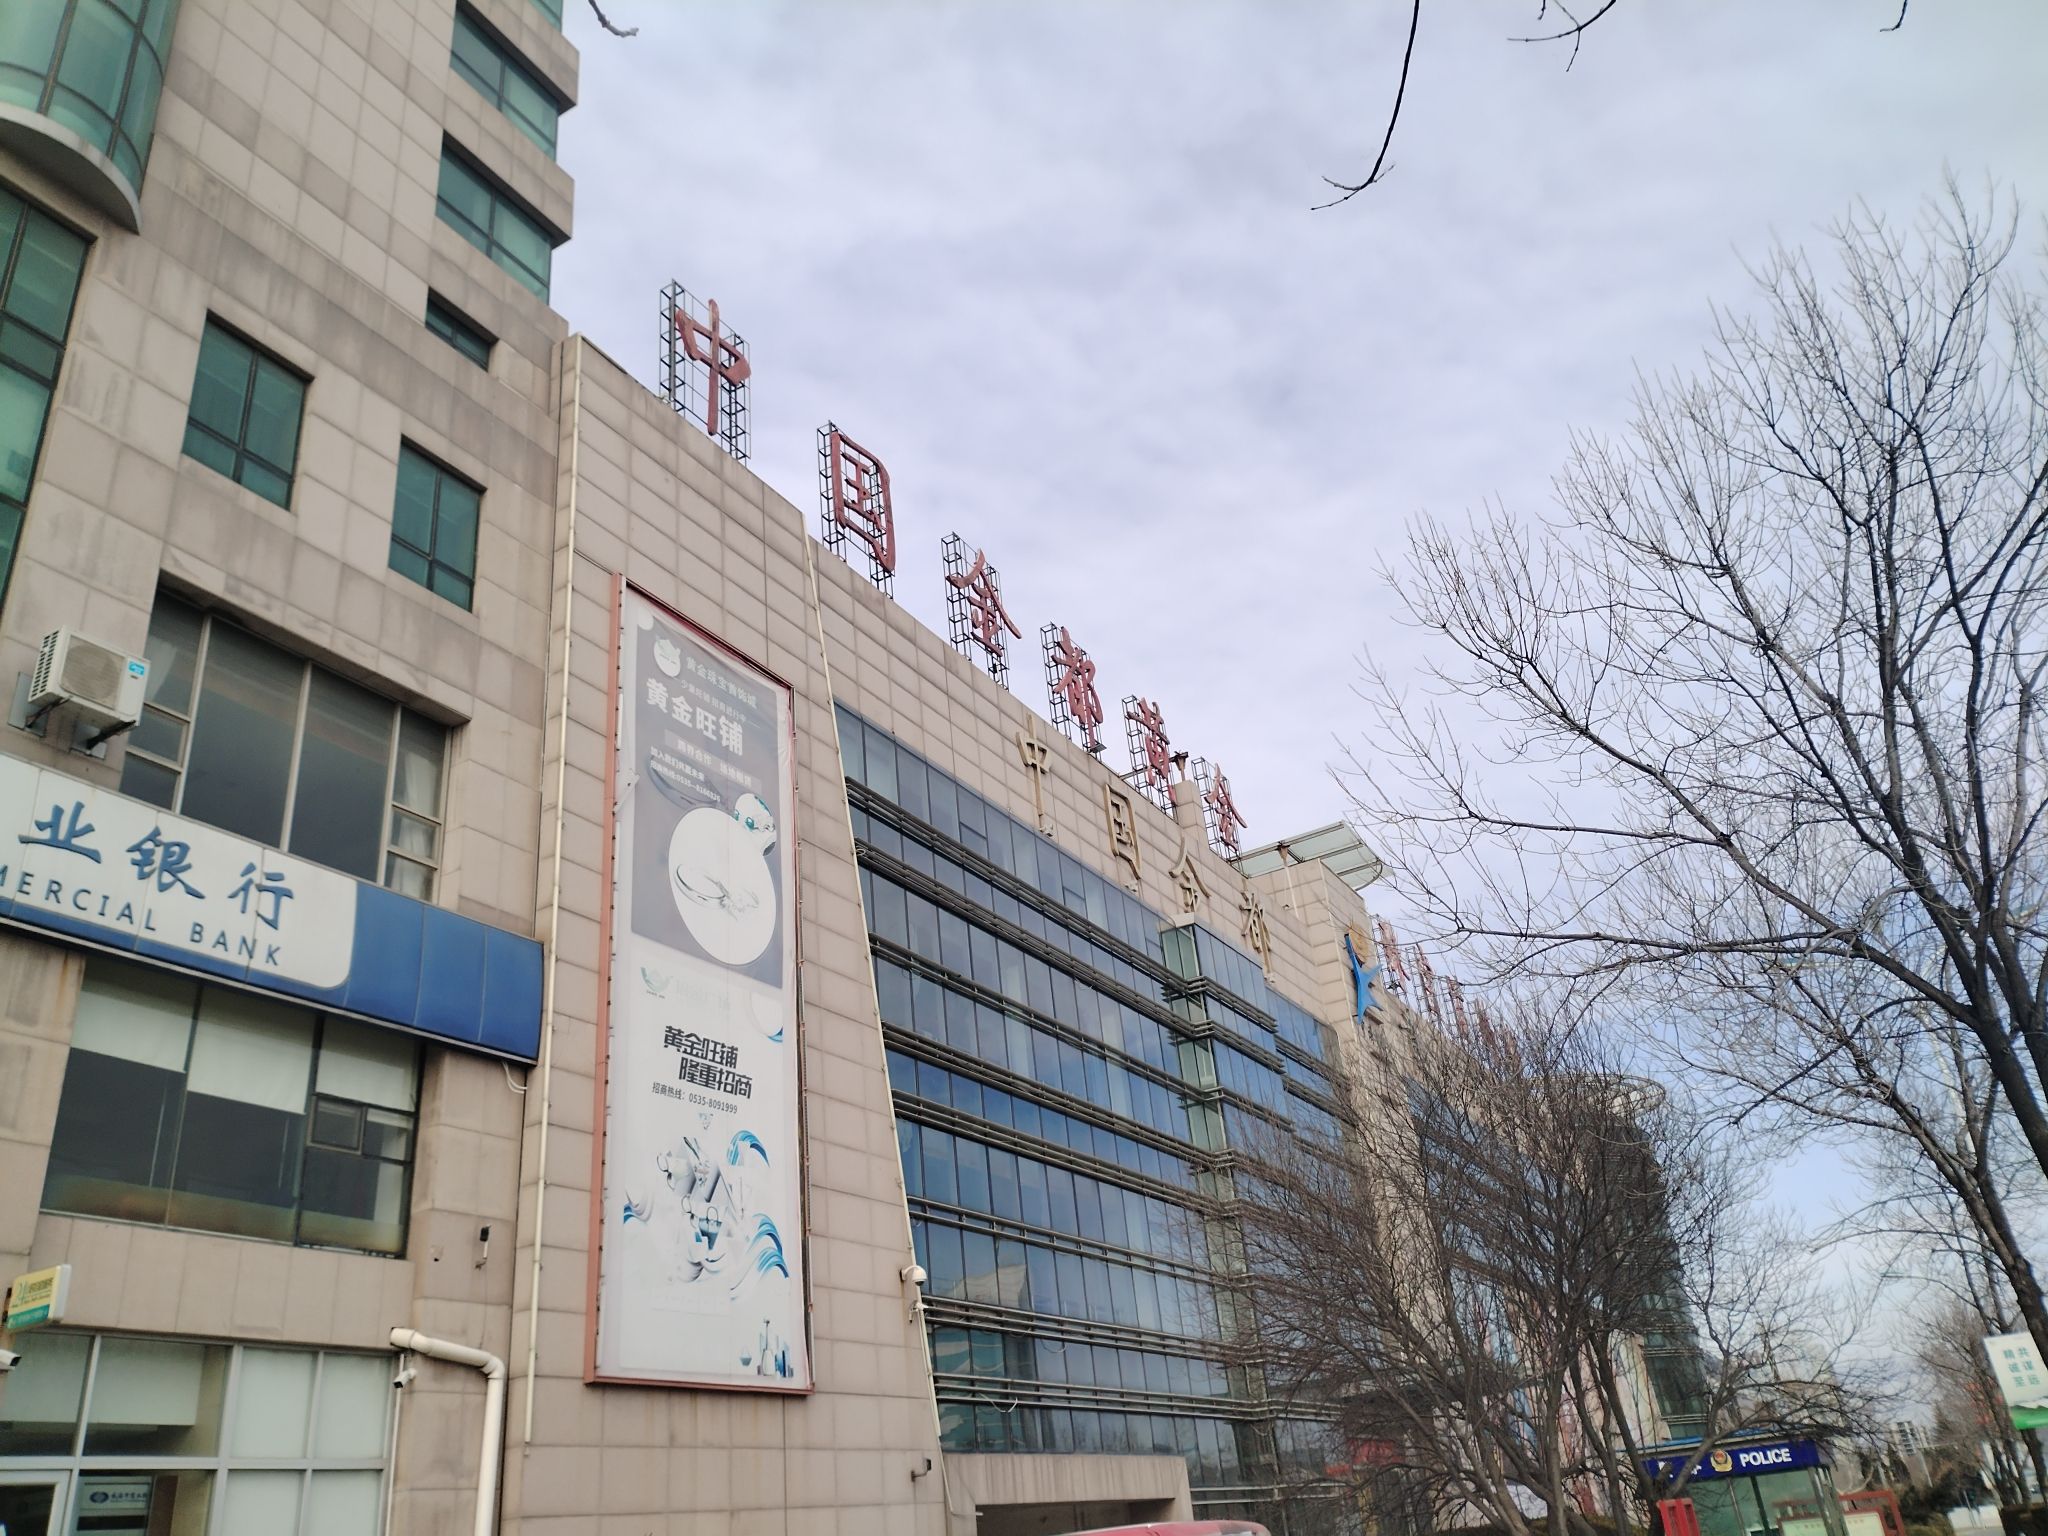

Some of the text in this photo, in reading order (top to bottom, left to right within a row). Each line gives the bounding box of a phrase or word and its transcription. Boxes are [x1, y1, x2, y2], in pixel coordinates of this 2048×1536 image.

[646, 678, 742, 756] 黄金旺铺
[18, 800, 294, 931] 业银行
[190, 922, 281, 967] BANK
[664, 1025, 738, 1069] 黄金旺铺
[679, 1056, 753, 1100] 隆重招商
[1740, 1448, 1792, 1467] POLICE
